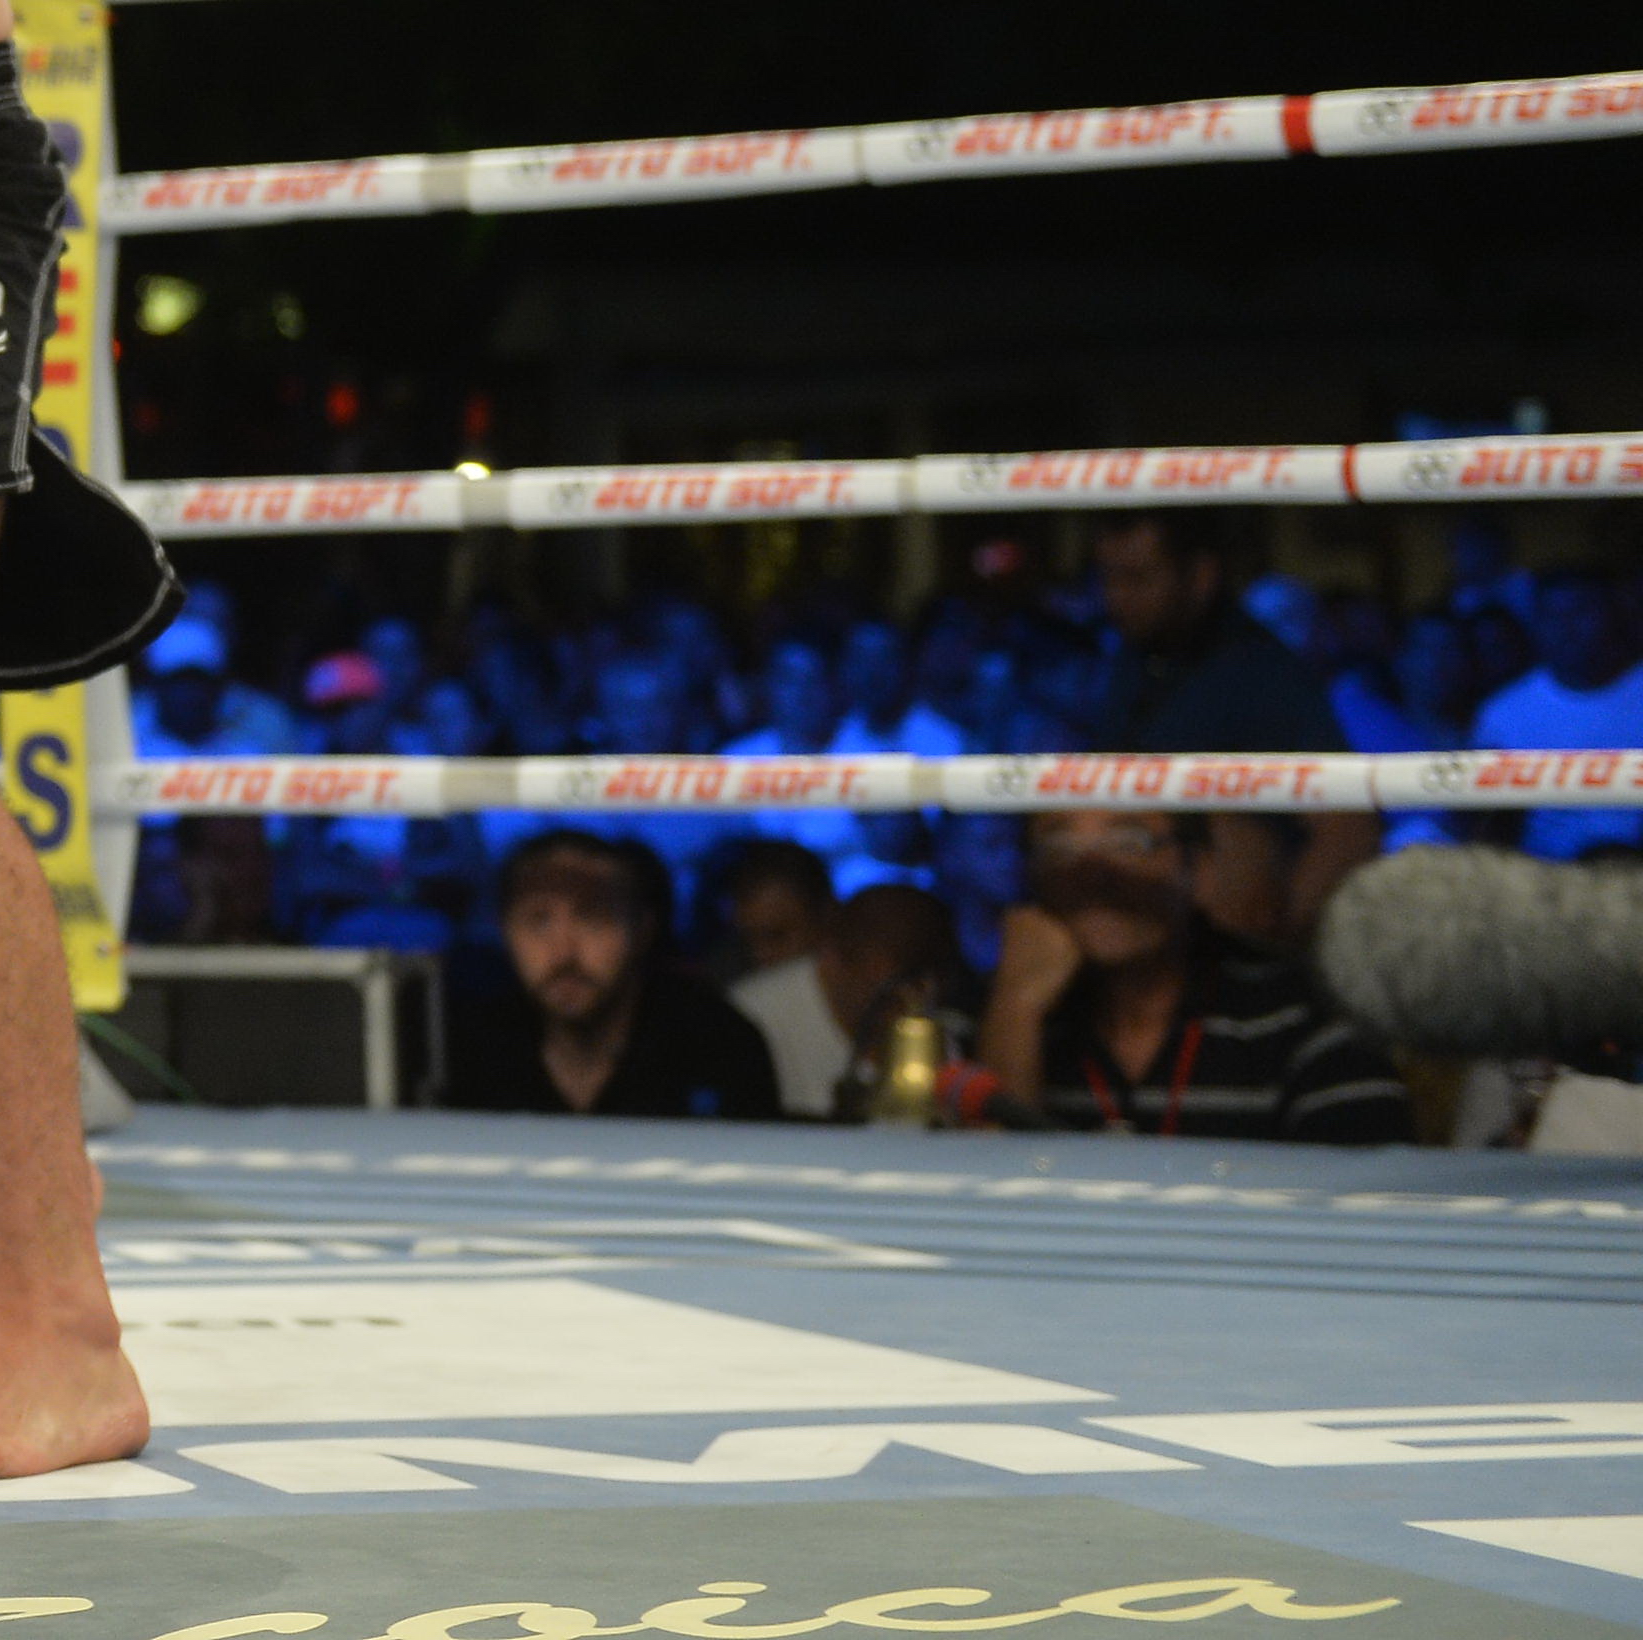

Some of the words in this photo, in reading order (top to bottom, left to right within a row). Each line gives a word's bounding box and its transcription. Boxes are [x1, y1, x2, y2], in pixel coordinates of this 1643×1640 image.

[1411, 82, 1557, 130] AUTO
[954, 110, 1087, 156] AUTO
[550, 137, 678, 182] AUTO
[142, 168, 257, 210] AUTO
[1007, 449, 1145, 490] AUTO
[1459, 445, 1605, 486] AUTO
[181, 483, 296, 523] AUTO
[594, 471, 720, 511] AUTO
[159, 766, 277, 804] AUTO
[603, 760, 730, 800] AUTO
[1035, 754, 1173, 797] AUTO
[1475, 754, 1623, 789] AUTO
